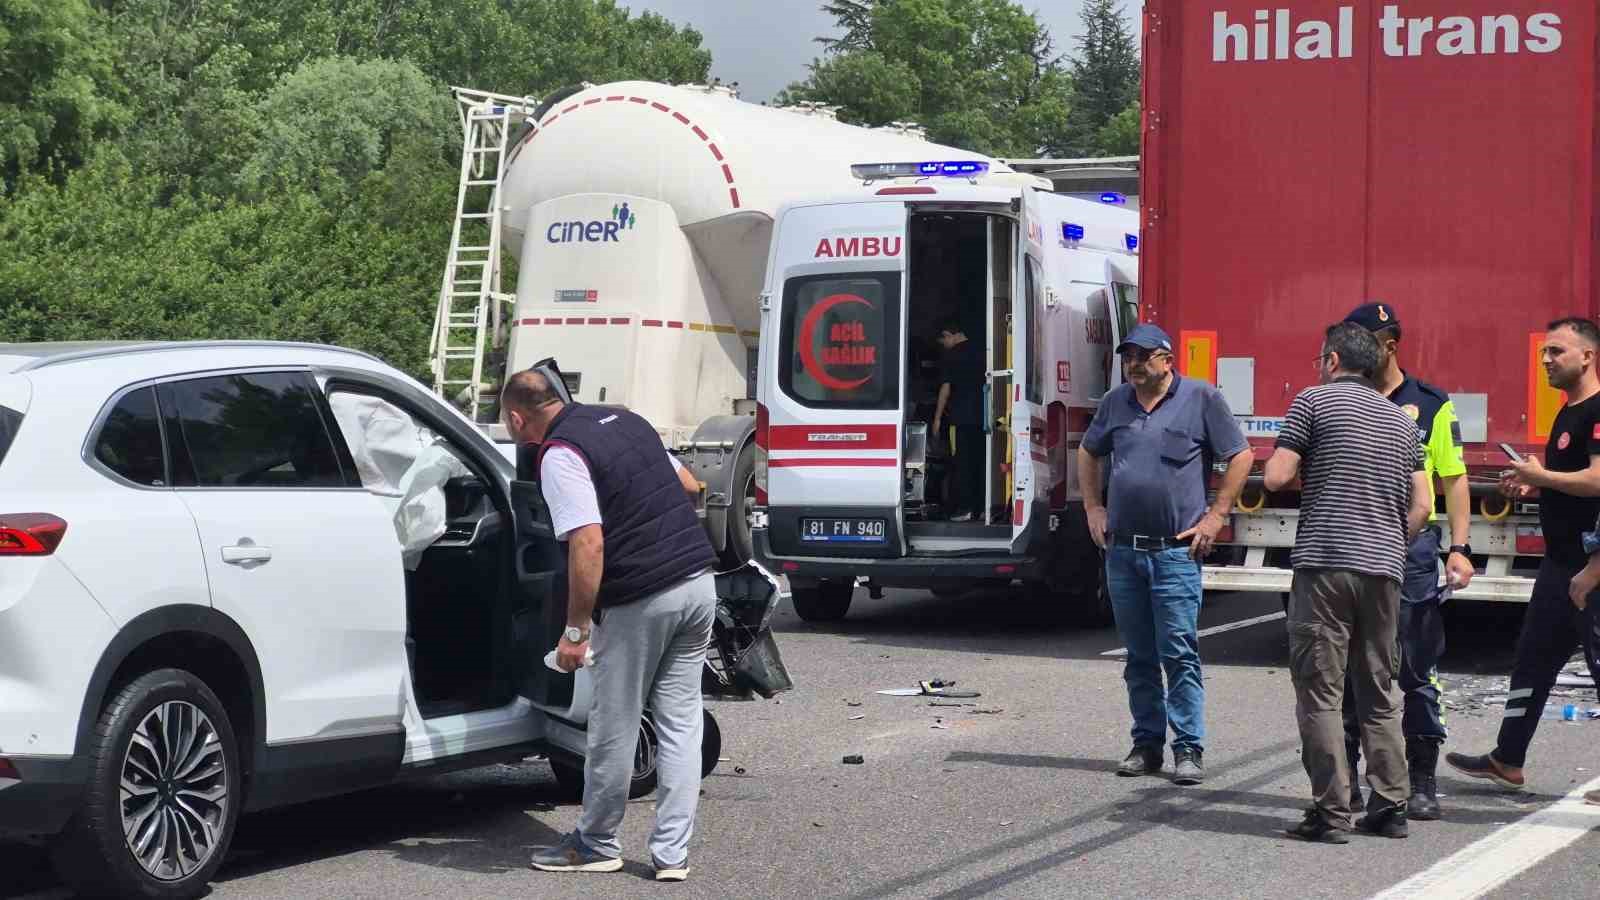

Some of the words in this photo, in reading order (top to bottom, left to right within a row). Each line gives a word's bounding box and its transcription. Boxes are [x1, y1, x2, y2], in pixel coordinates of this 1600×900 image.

[1212, 6, 1353, 62] hilal
[1379, 5, 1562, 57] trans
[814, 236, 901, 258] AMBU
[810, 521, 824, 535] 81
[833, 521, 851, 535] FN
[857, 521, 882, 536] 940
